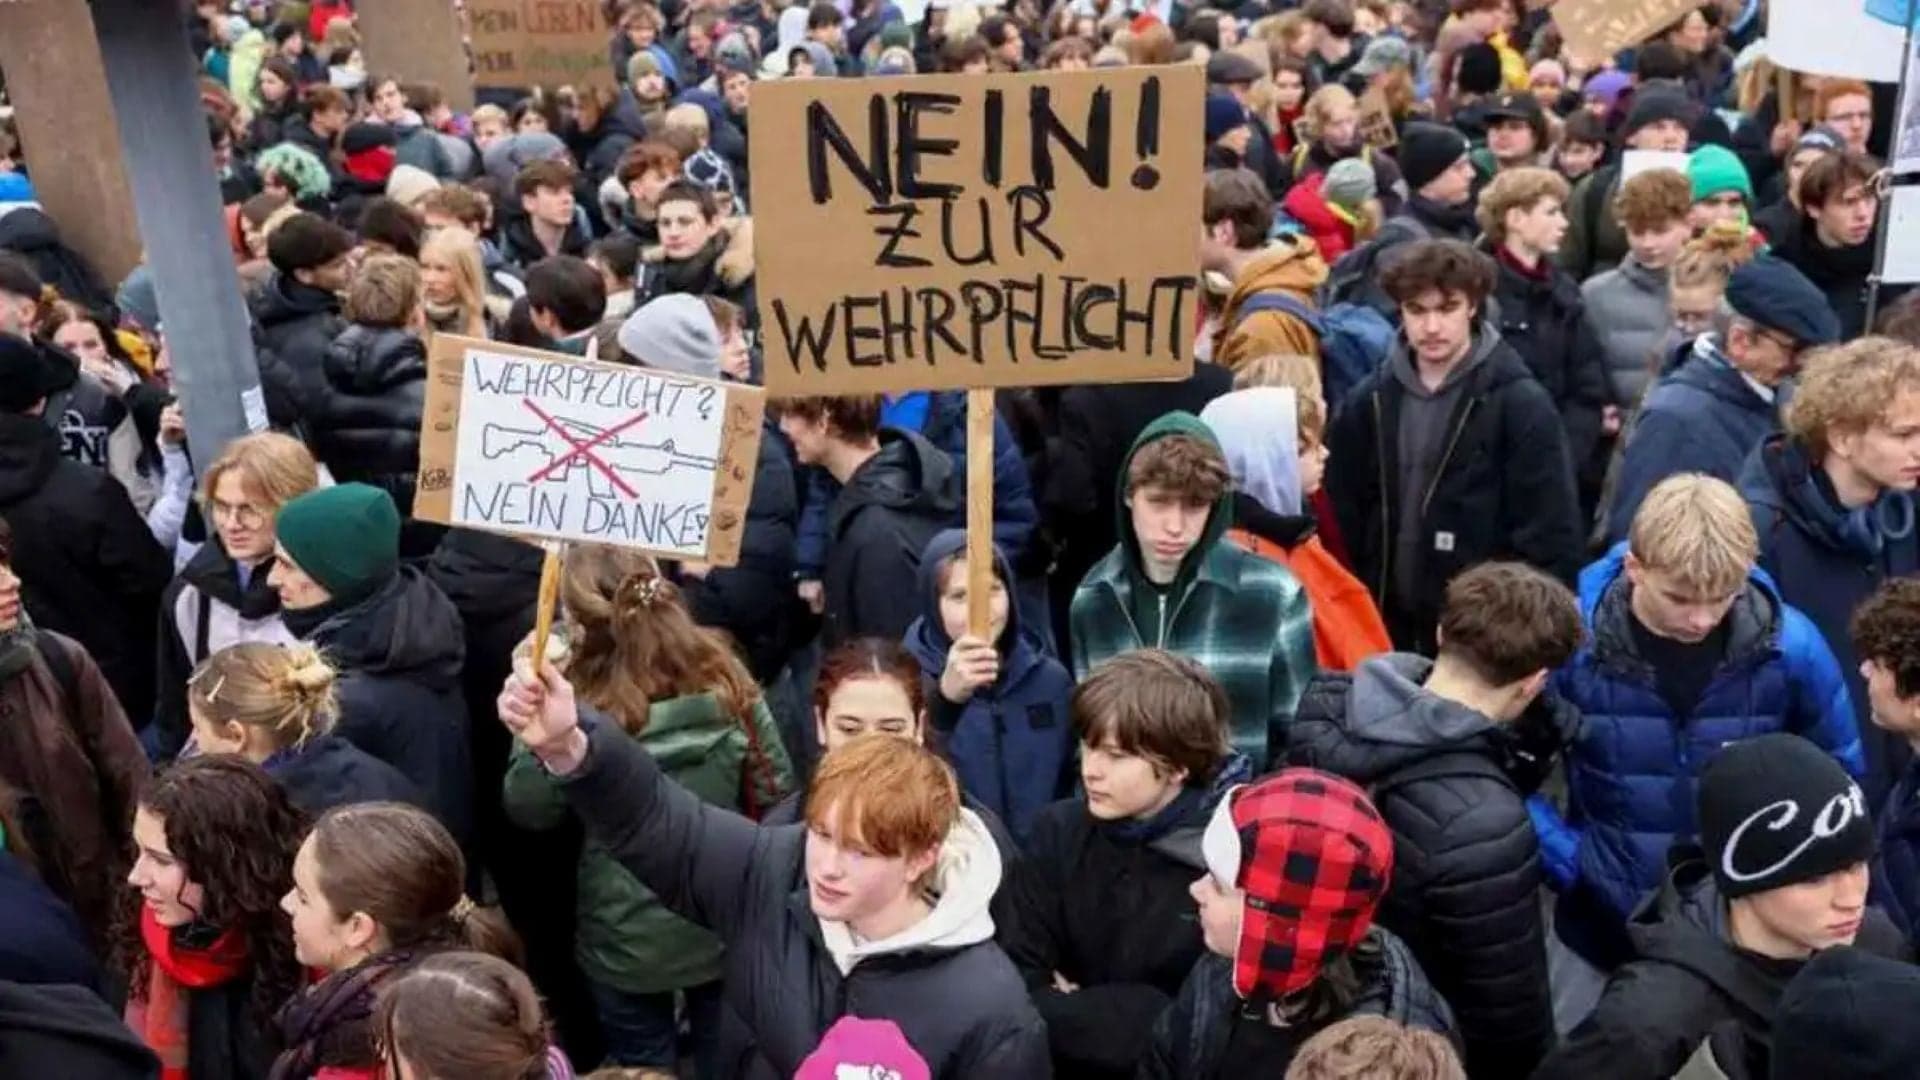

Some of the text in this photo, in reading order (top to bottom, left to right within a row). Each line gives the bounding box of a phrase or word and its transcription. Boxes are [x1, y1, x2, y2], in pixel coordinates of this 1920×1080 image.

[806, 76, 1161, 204] NEIN!
[866, 185, 1064, 267] ZUR
[772, 274, 1197, 374] WEHRPFLICHT
[463, 482, 567, 532] NEIN
